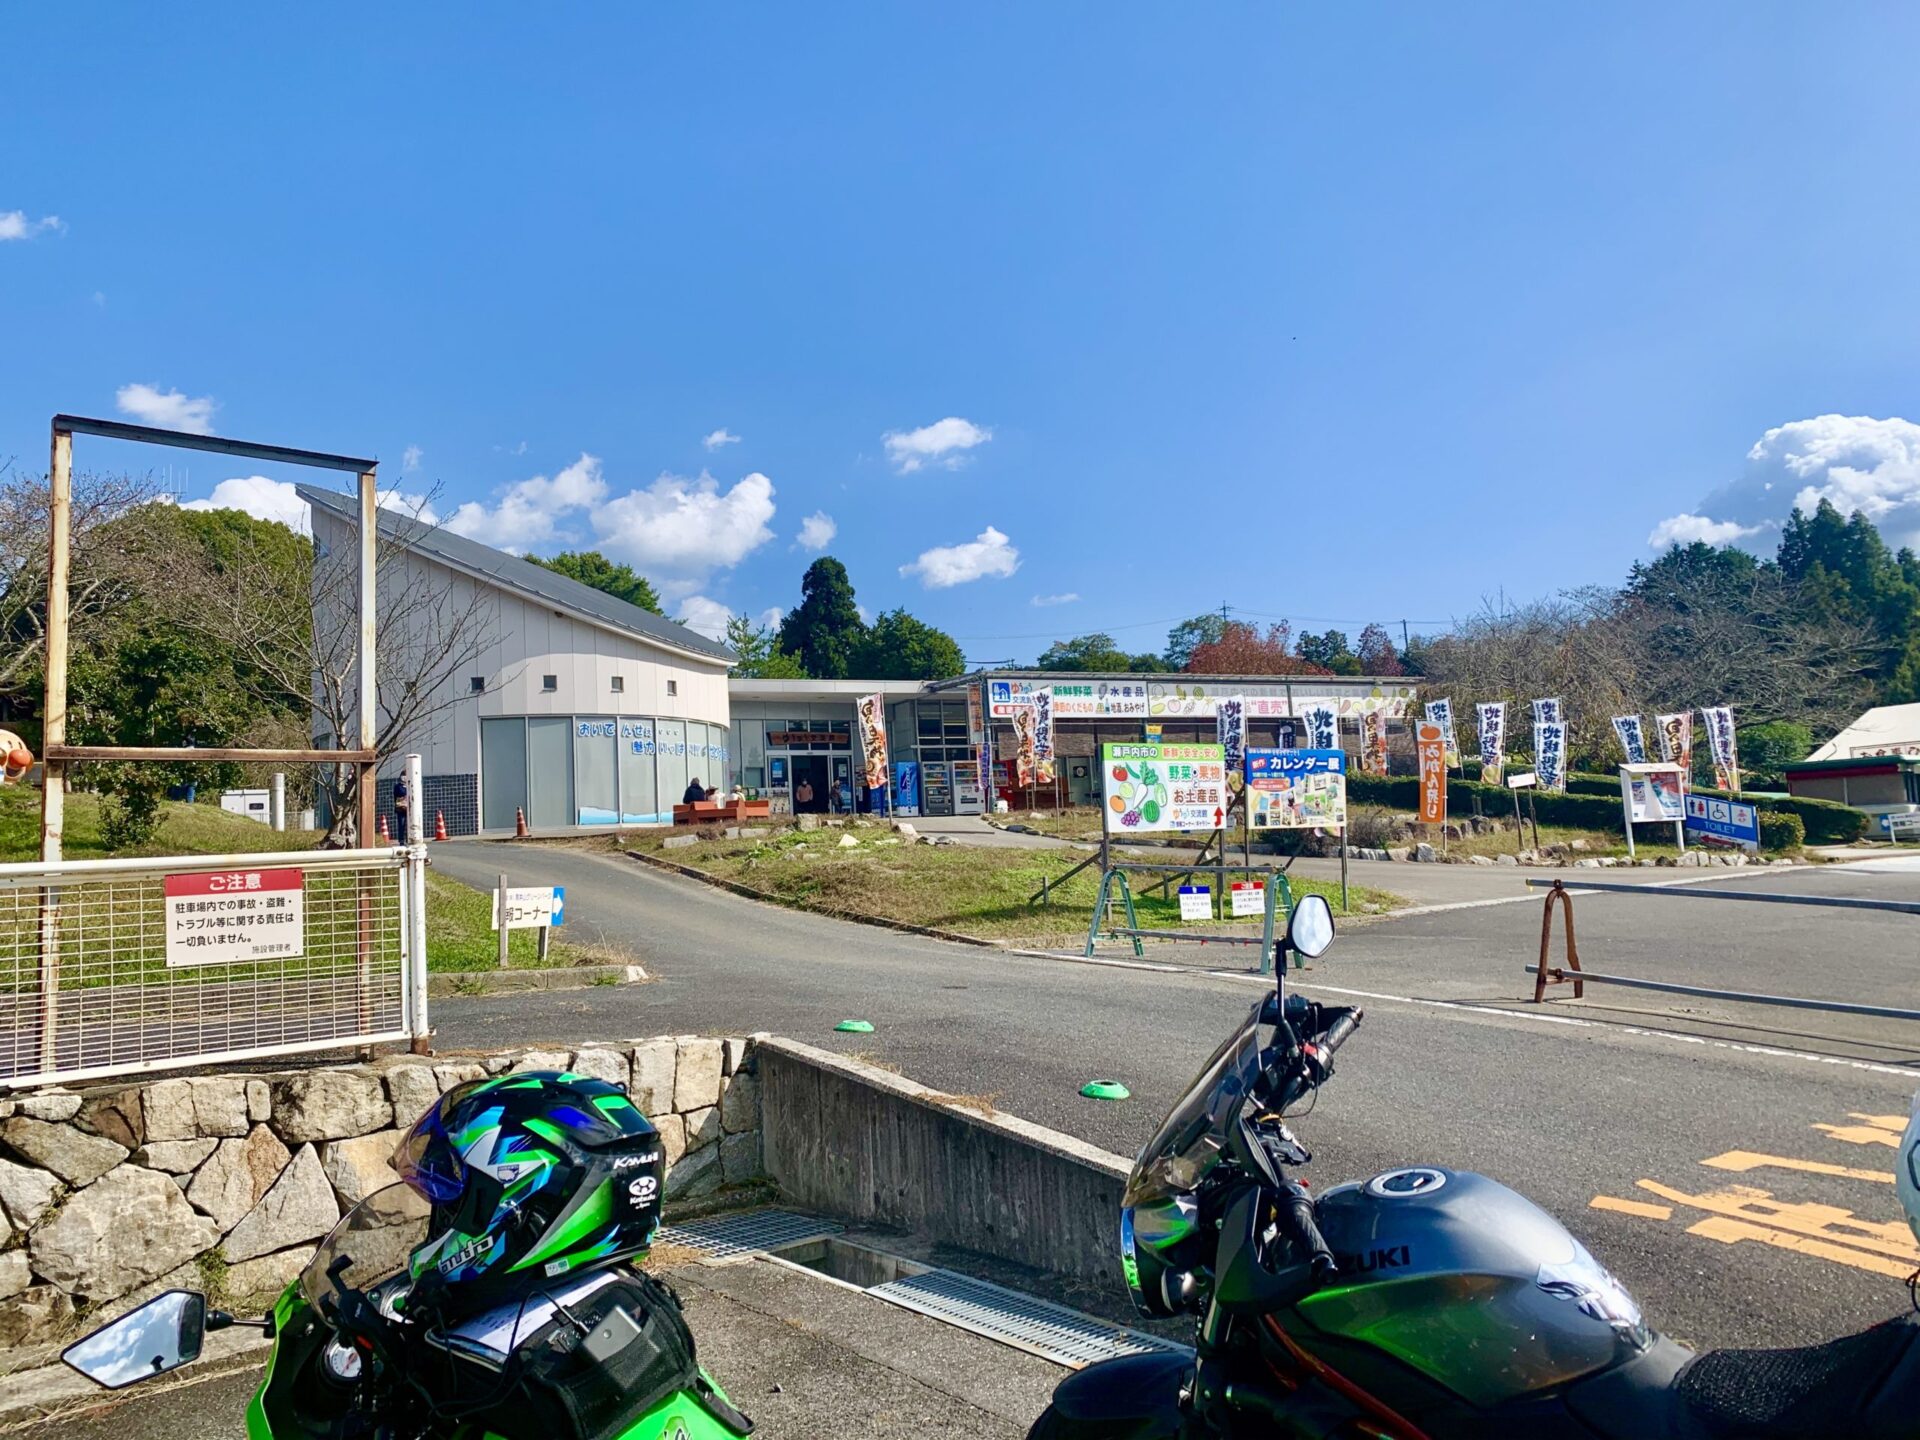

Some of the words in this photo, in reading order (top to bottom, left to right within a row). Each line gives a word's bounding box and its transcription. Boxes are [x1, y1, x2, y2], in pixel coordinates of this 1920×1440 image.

[1053, 685, 1092, 697] 新鮮野菜
[1110, 686, 1144, 697] 水産品
[1112, 746, 1158, 757] 瀬戸内市の
[1270, 757, 1340, 770] カレンダー展
[1168, 765, 1220, 780] 野菜・果物
[1174, 789, 1219, 803] お土産品
[1704, 821, 1737, 834] TOILET
[209, 873, 262, 891] ご注意
[497, 905, 550, 922] 報コーナー
[176, 912, 294, 931] トラブル等に関する責任は
[175, 933, 252, 947] 一切負いません。
[252, 943, 291, 954] 施設管理者
